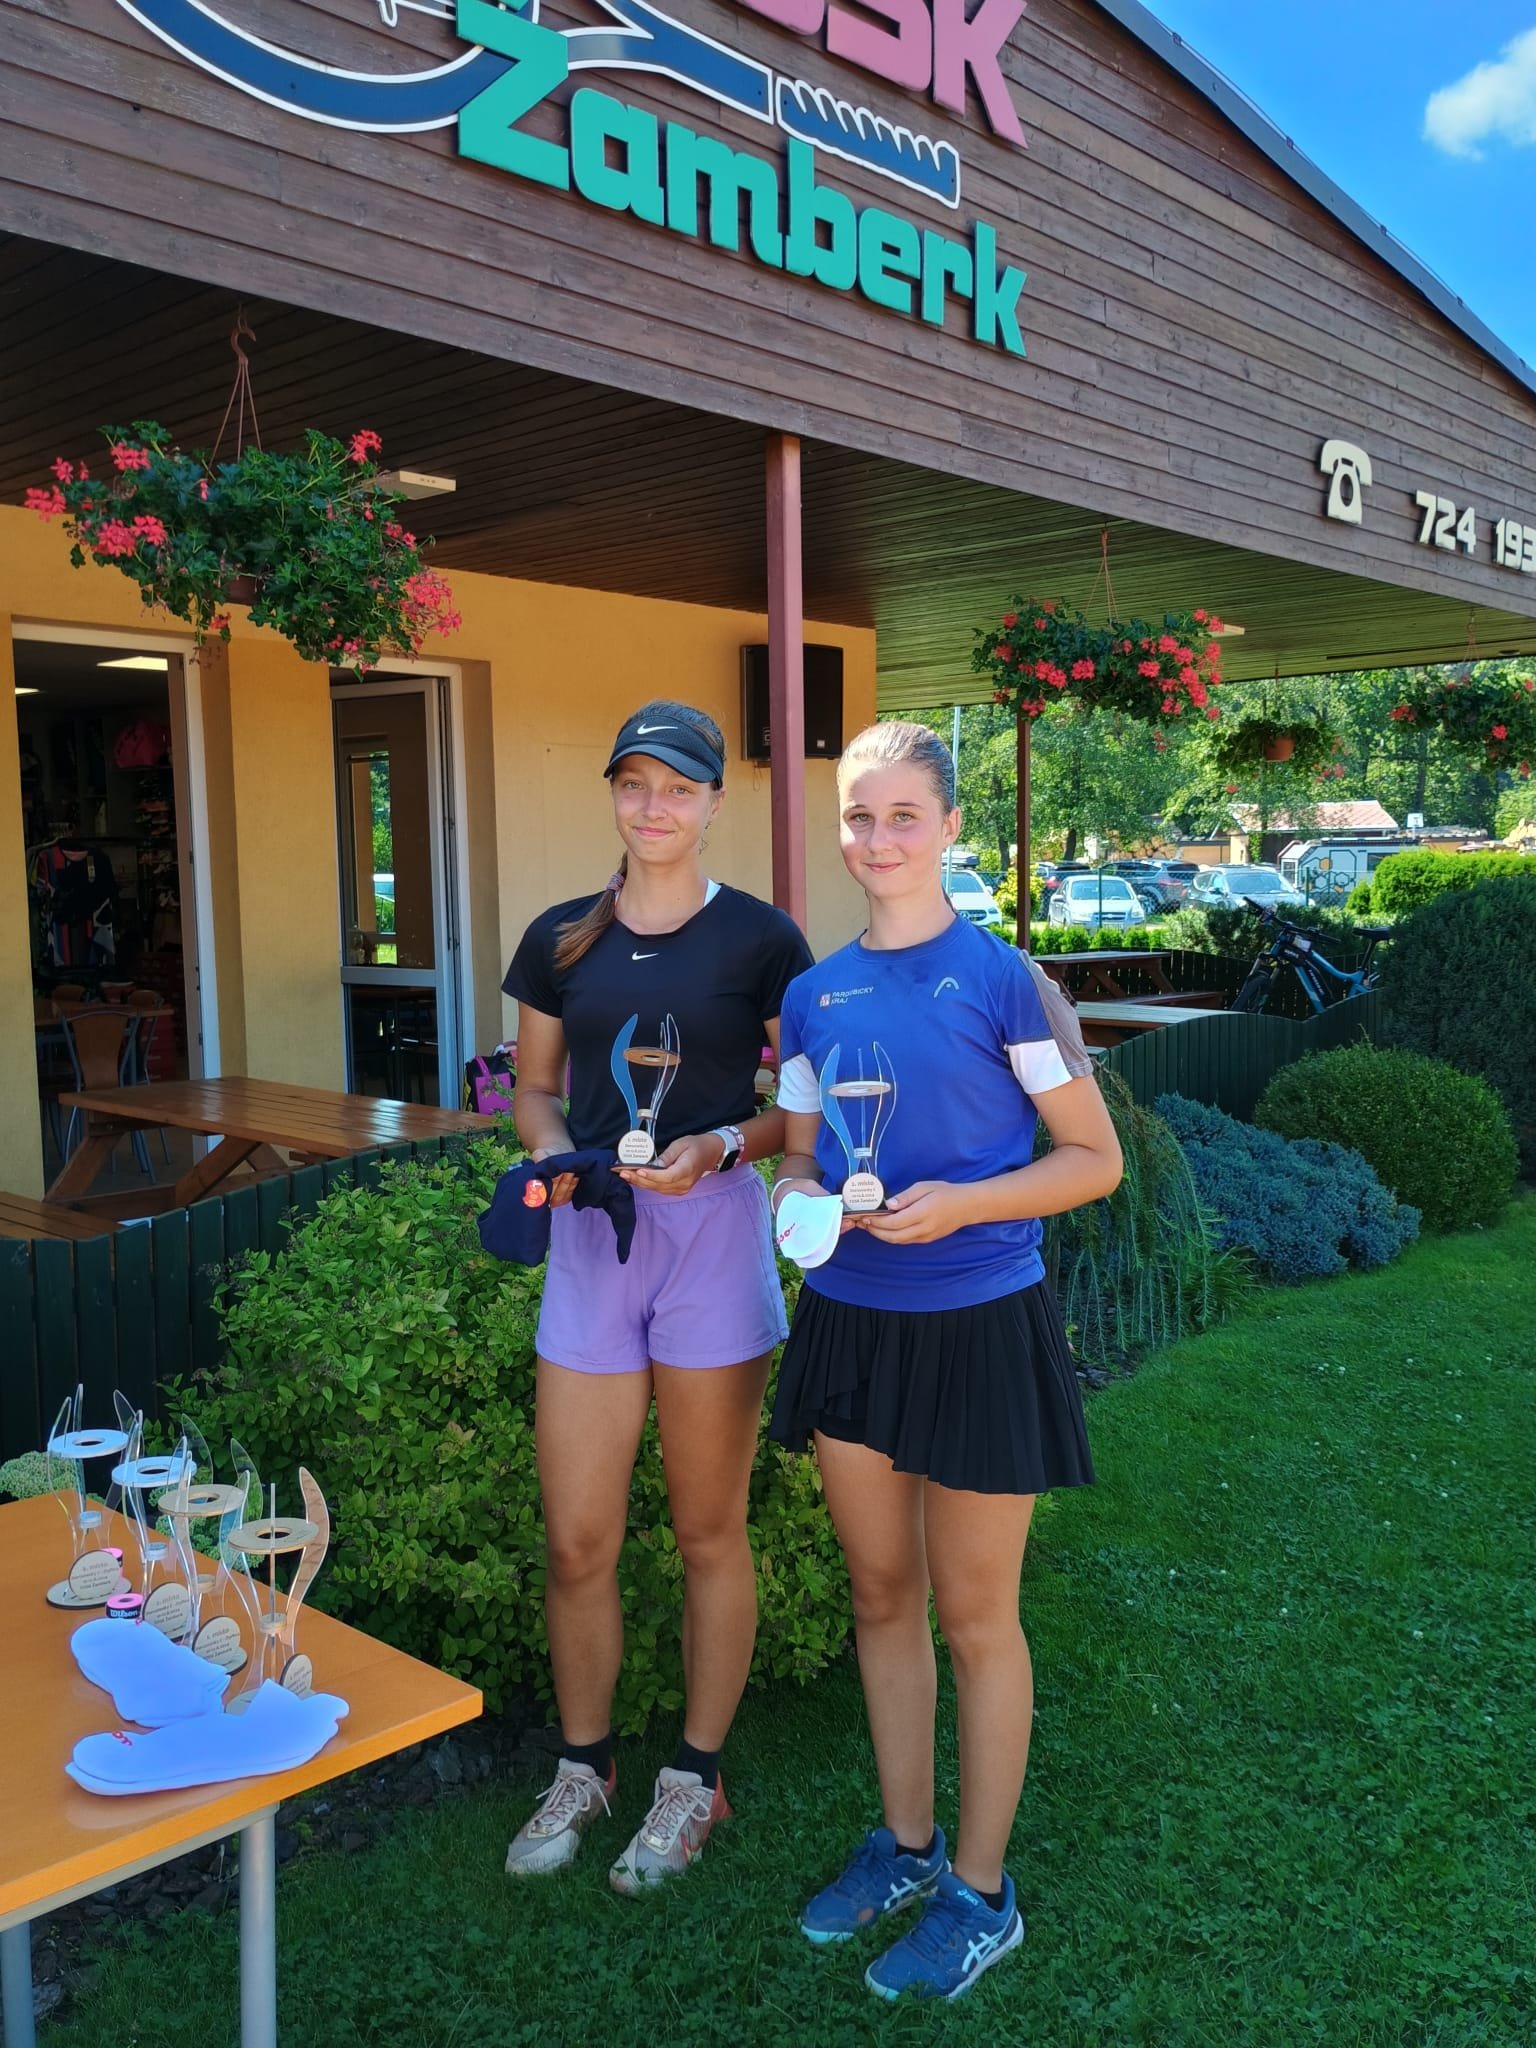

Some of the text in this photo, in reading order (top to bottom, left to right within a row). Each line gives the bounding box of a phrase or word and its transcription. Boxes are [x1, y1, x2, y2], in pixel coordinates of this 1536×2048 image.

[741, 0, 1028, 149] SK
[1416, 489, 1536, 573] 724 193
